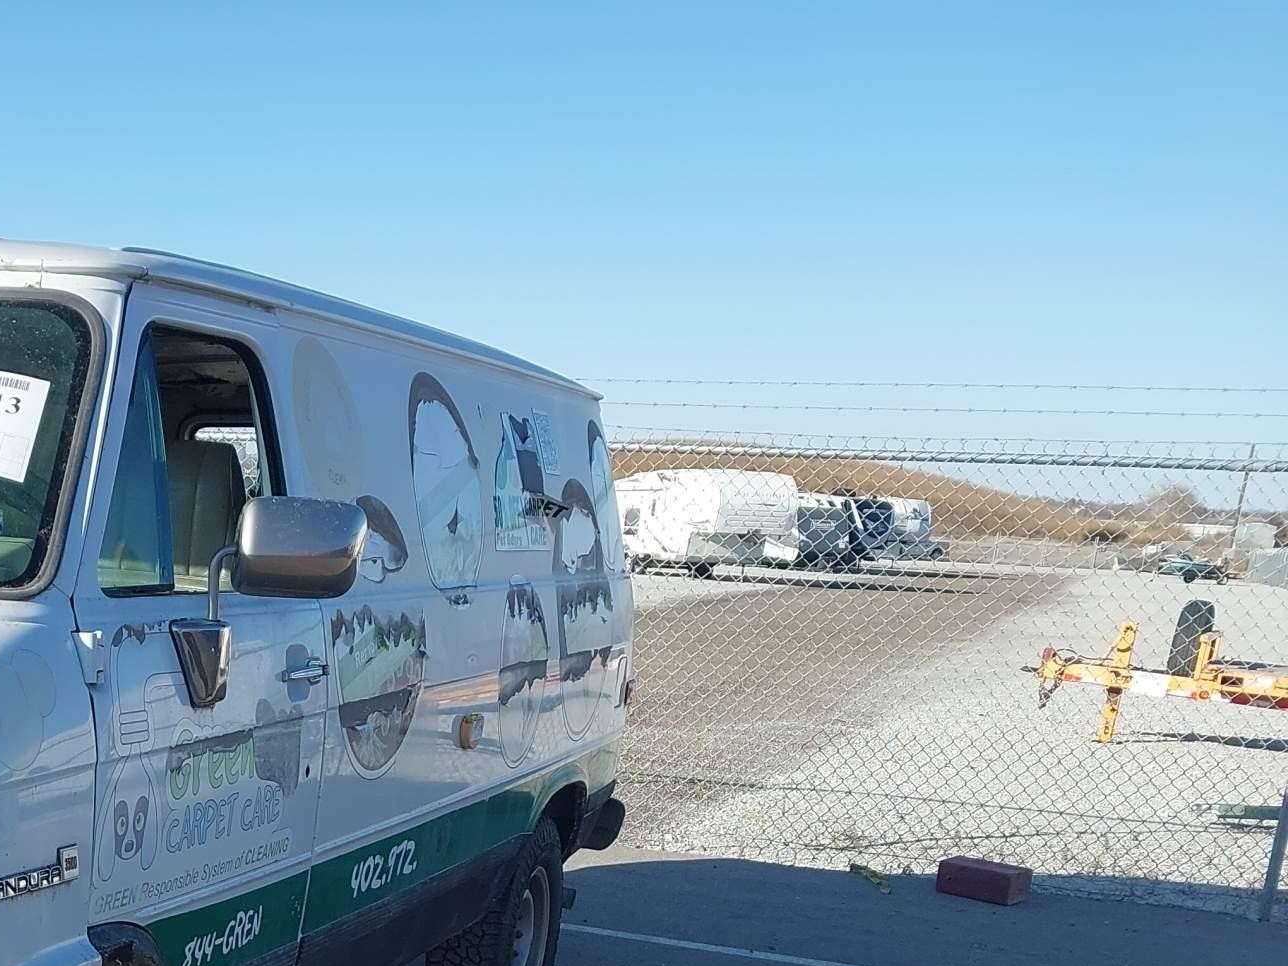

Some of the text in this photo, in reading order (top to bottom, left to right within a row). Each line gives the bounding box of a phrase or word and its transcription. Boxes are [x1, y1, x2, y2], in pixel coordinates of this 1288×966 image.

[165, 785, 281, 854] CARPET CARE
[95, 837, 290, 915] GREEN Responsible System of CLEANING
